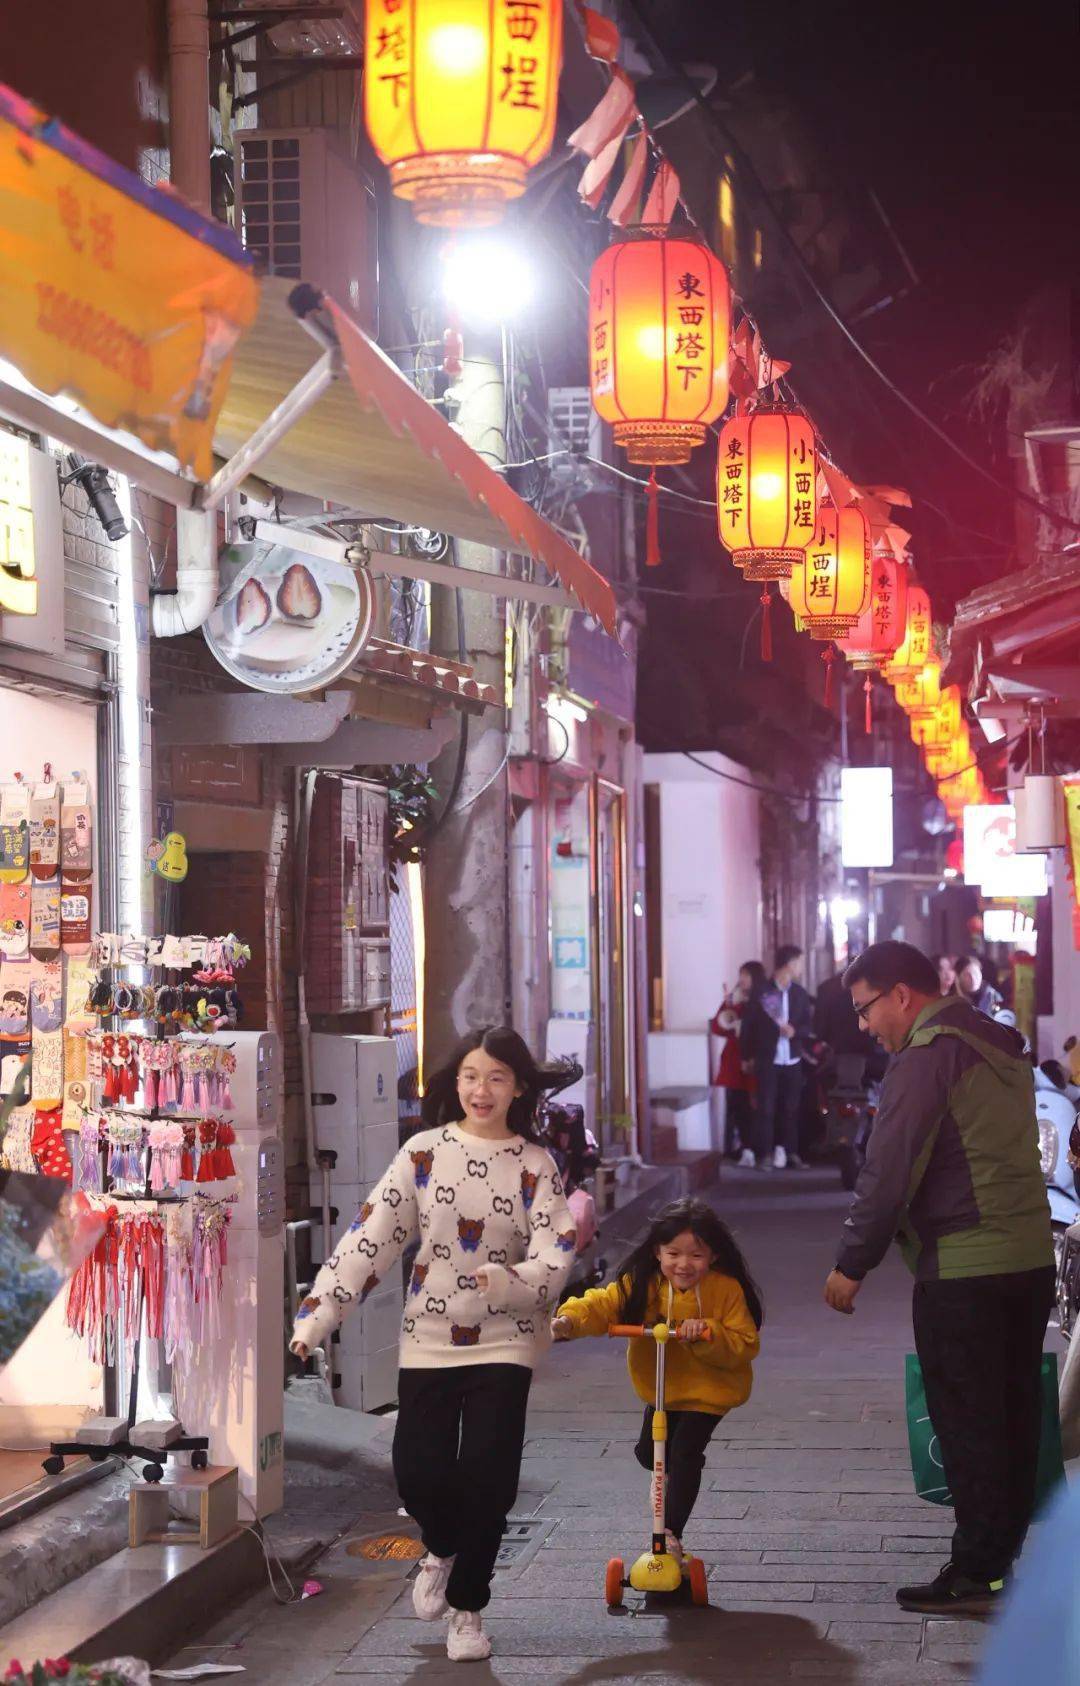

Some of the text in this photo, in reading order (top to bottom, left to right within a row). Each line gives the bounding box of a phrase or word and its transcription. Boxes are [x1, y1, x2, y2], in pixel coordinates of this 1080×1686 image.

[675, 272, 706, 391] 東西塔下
[723, 438, 745, 528] 東西塔下
[792, 439, 815, 529] 小西埕
[809, 526, 836, 599] 小西埕
[875, 574, 893, 635] 東西塔下
[656, 1461, 662, 1472] BE
